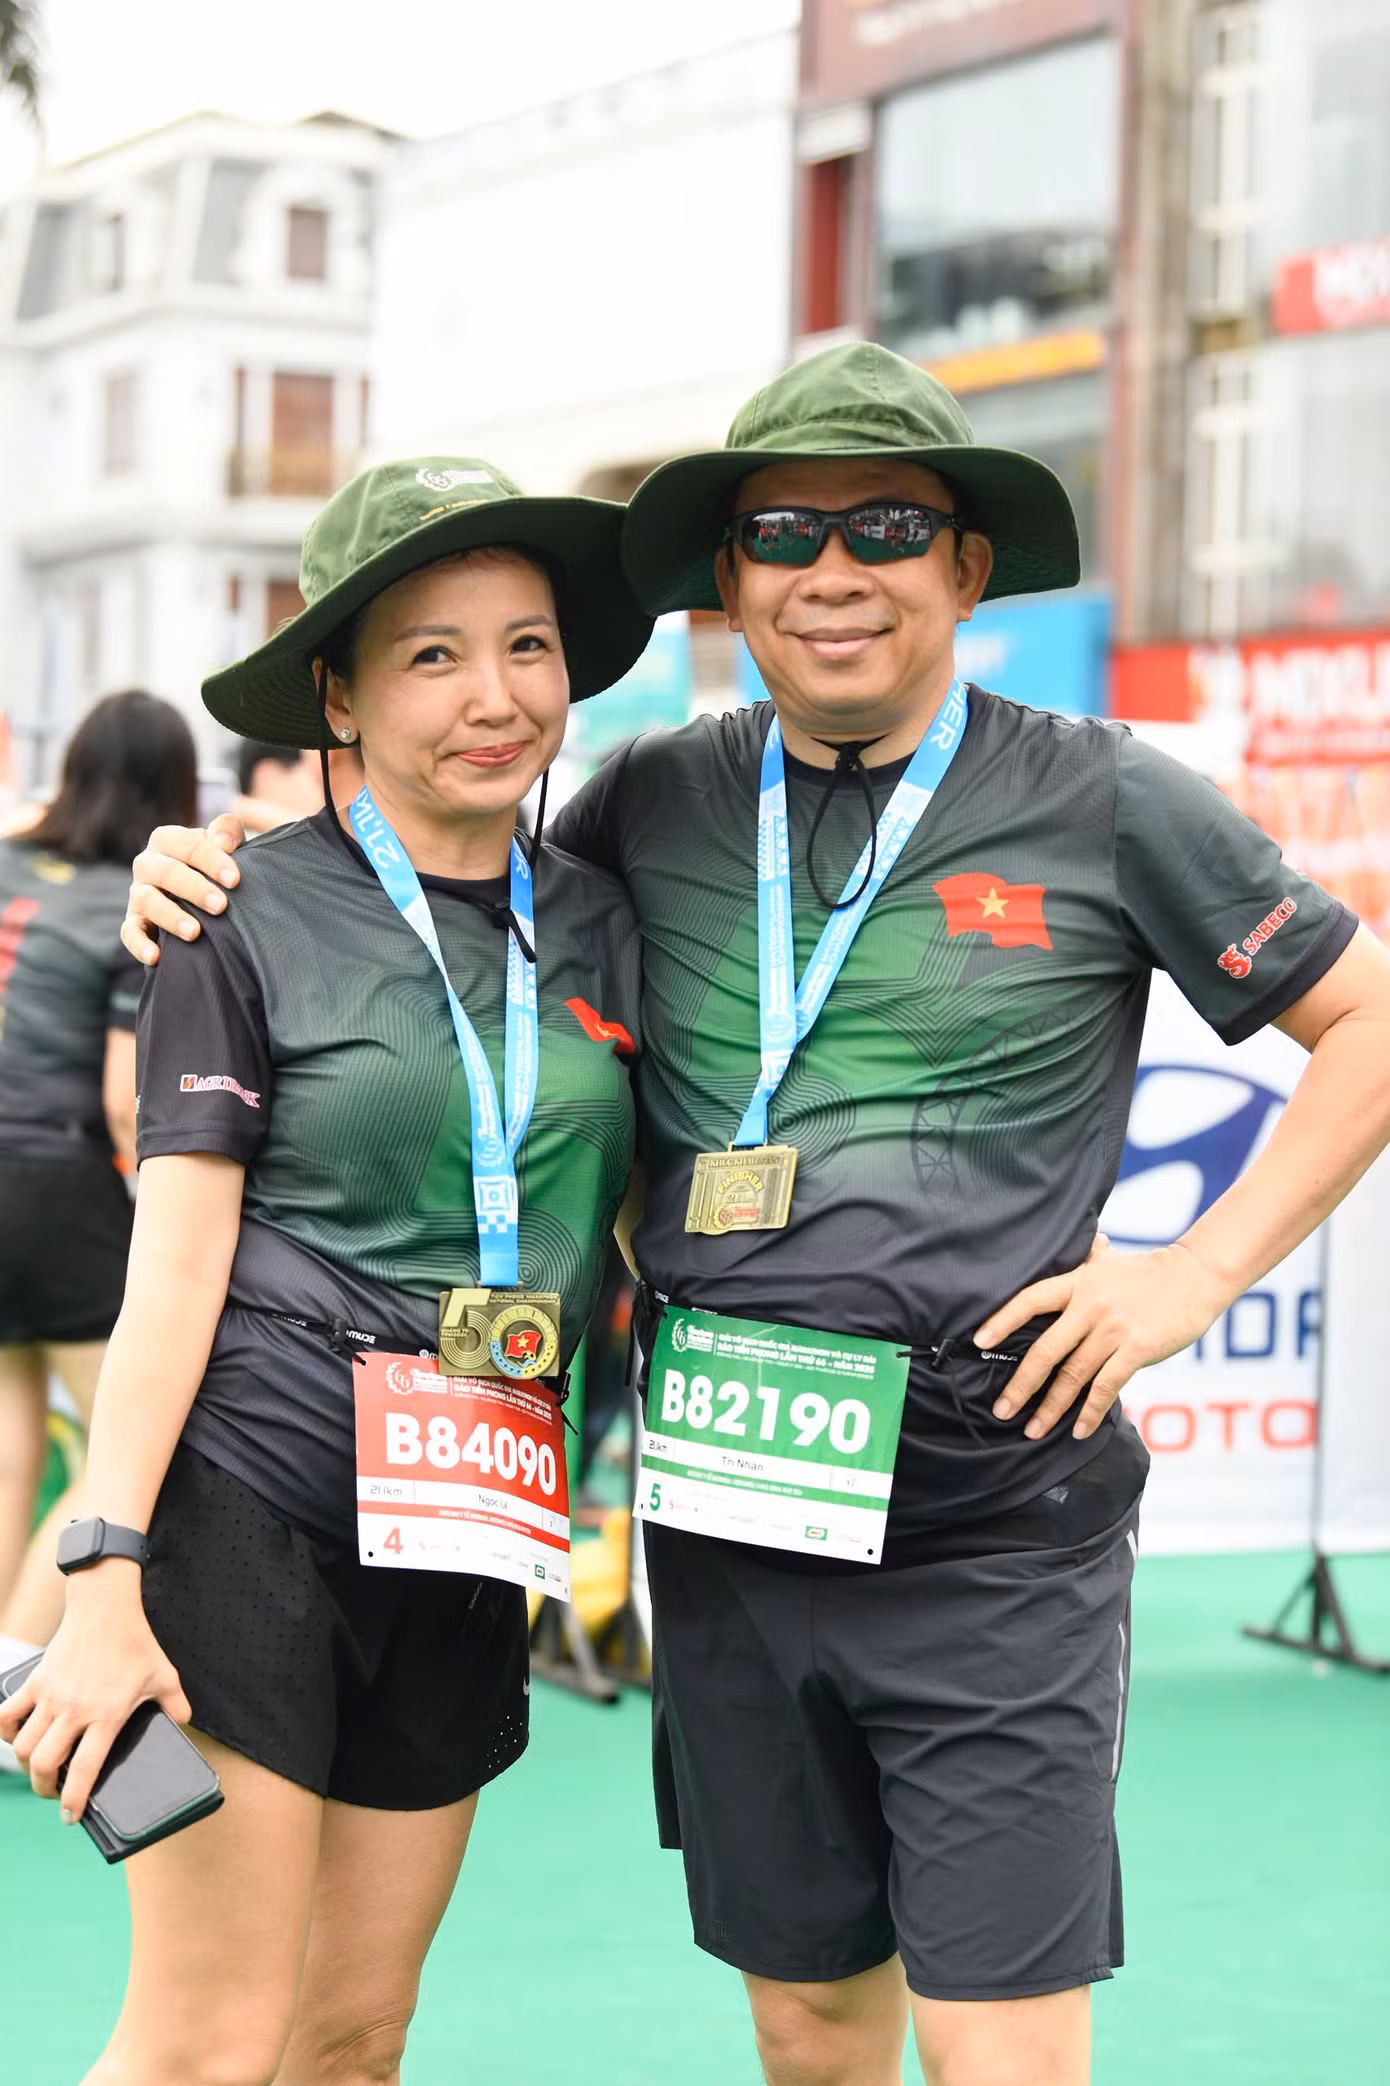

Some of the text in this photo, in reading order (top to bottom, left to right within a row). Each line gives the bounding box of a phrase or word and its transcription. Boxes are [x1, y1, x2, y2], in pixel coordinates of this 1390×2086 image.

[1242, 896, 1298, 957] SABECO
[717, 1169, 765, 1194] FINISHER
[660, 1368, 872, 1455] B82190
[385, 1412, 558, 1497] B84090
[649, 1482, 661, 1511] 5
[383, 1526, 404, 1555] 4
